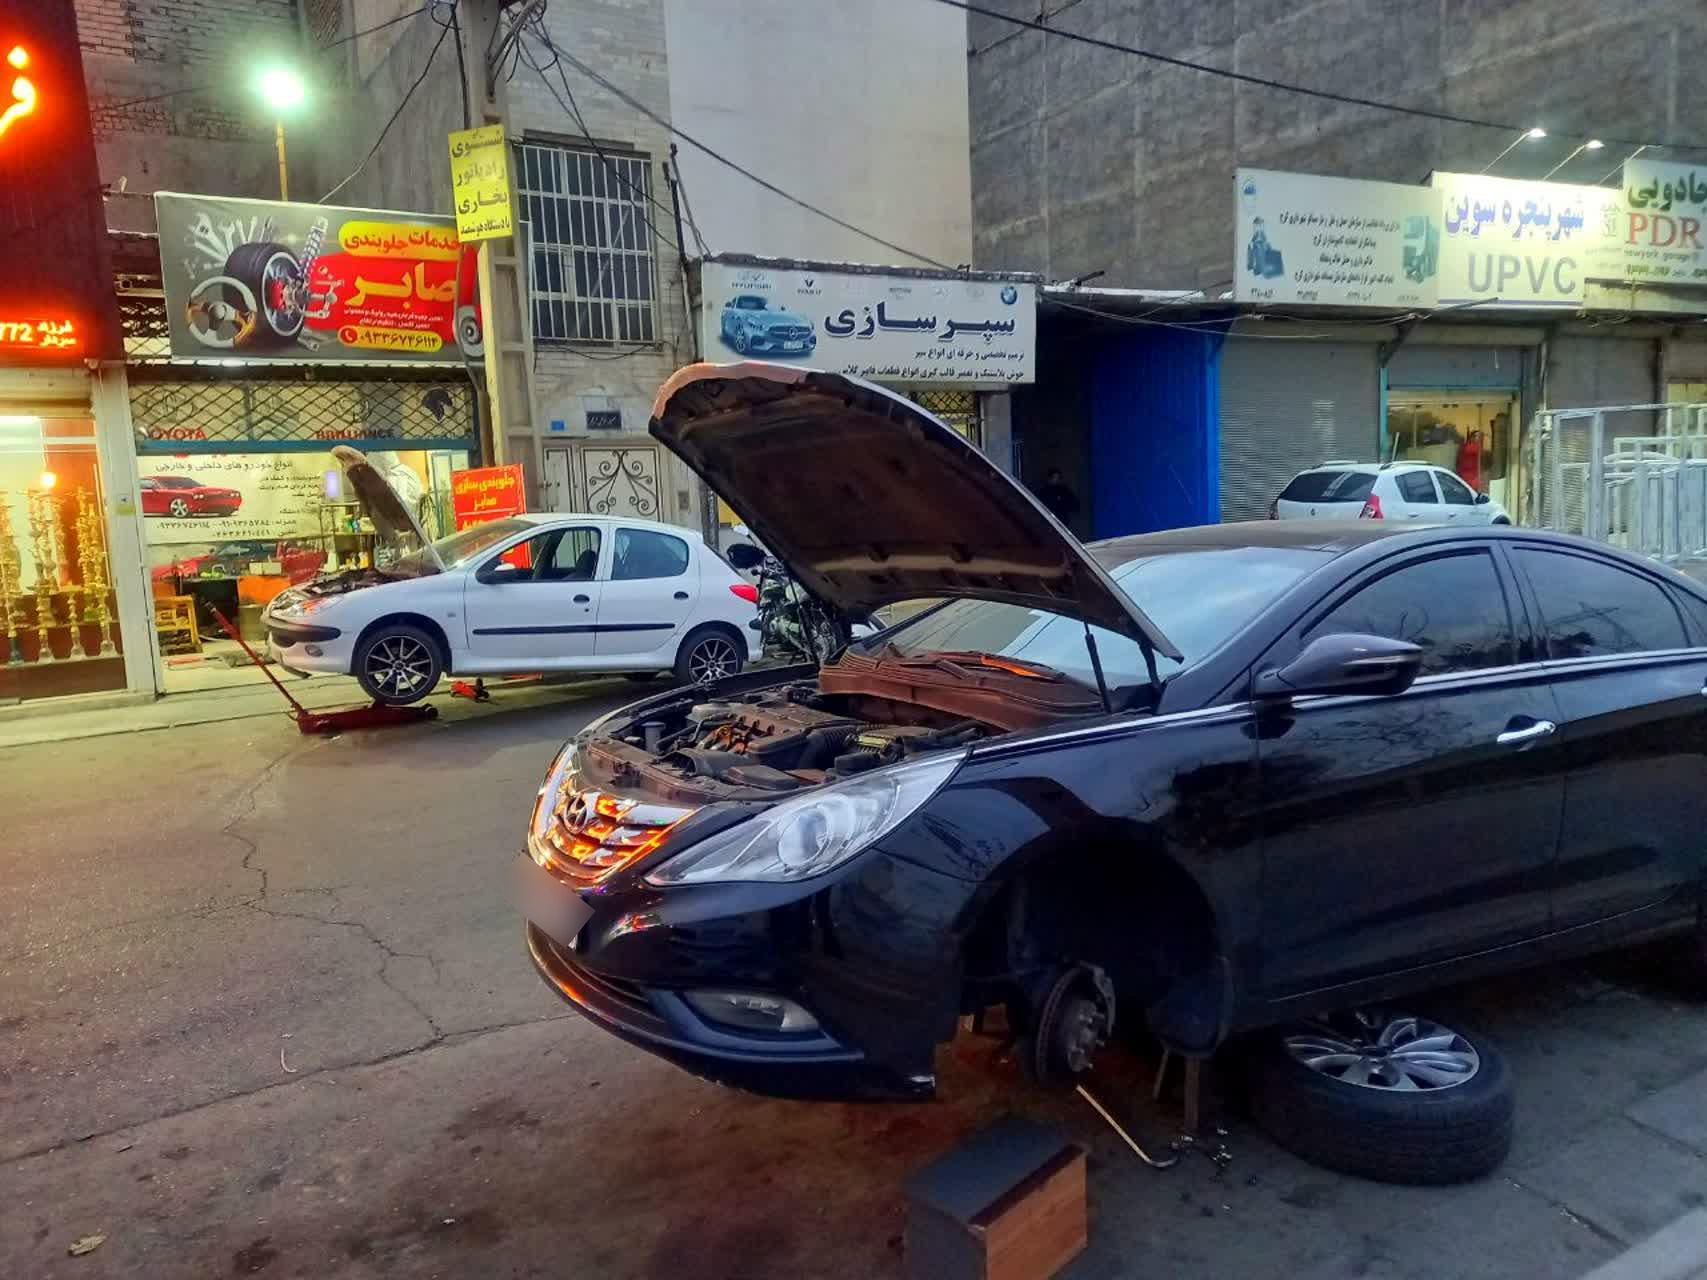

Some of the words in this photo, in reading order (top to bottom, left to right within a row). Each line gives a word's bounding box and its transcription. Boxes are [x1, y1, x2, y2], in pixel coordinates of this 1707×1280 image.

[459, 187, 508, 214] بخاری
[344, 234, 408, 254] جلوبندی
[1625, 212, 1704, 249] PDR
[344, 262, 456, 309] صابر
[1467, 253, 1577, 294] UPVC
